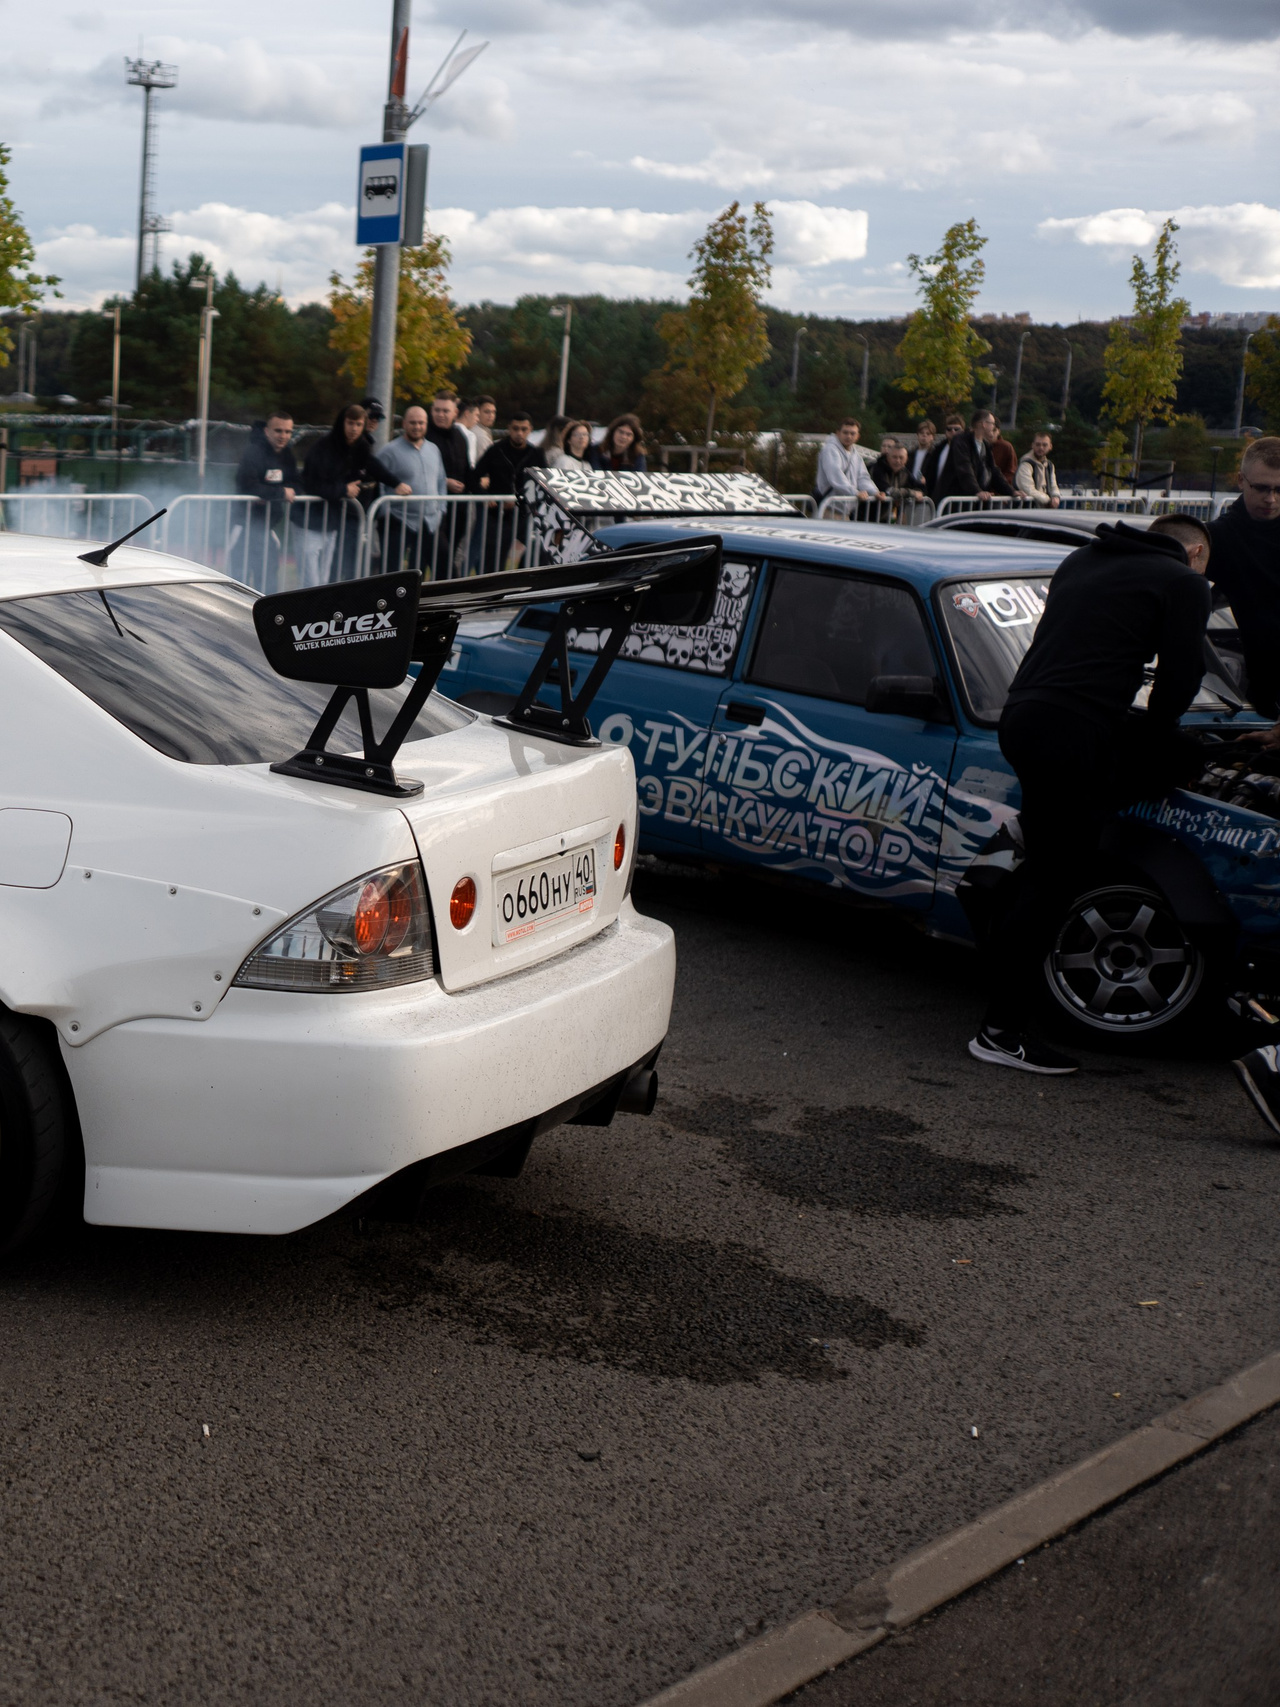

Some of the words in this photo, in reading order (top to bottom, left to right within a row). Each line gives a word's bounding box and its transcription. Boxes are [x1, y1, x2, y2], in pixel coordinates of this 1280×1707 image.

[291, 610, 395, 641] VOLTEX
[294, 641, 320, 651] VOLTEX
[321, 637, 346, 648] RACING
[347, 633, 374, 644] SUZUKA
[375, 630, 397, 640] JAPAN
[643, 719, 934, 826] ТУЛЬСКИЙ
[638, 775, 911, 877] ЭВАКУАТОР
[576, 854, 590, 884] 40
[575, 885, 586, 897] RUS
